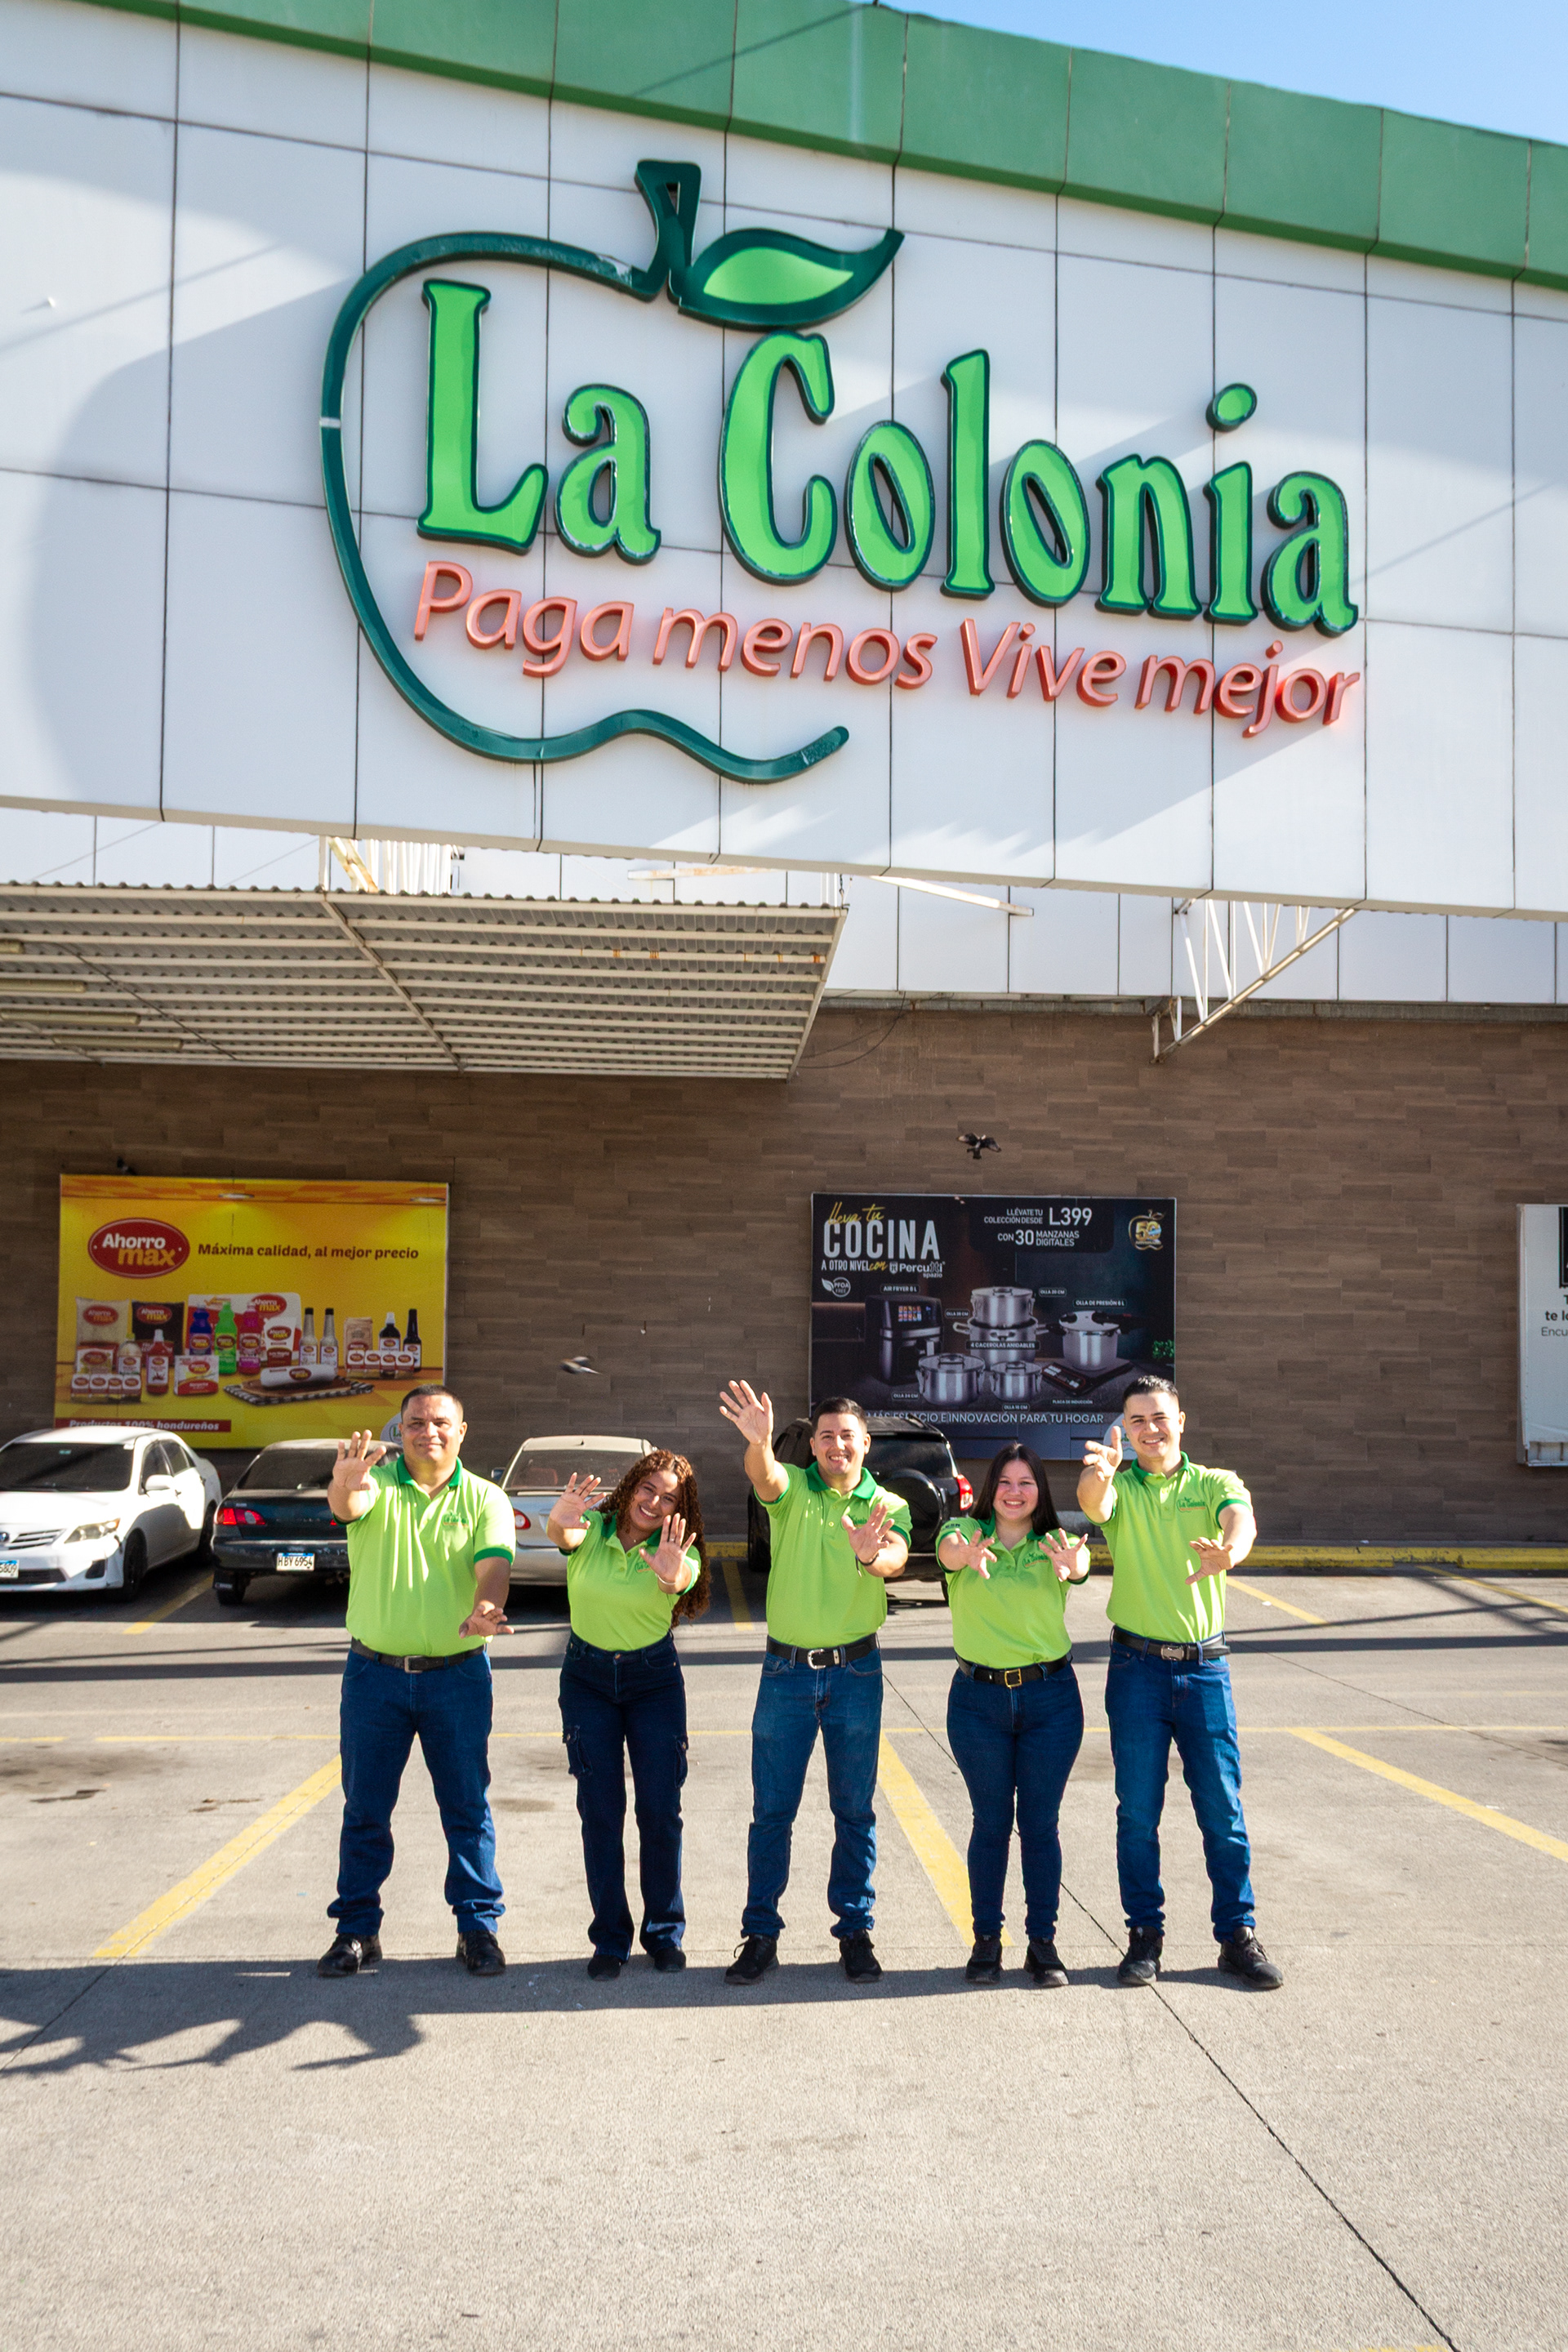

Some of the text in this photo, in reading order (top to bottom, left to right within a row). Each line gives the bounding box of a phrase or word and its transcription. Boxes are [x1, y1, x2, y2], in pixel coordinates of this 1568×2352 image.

[416, 278, 1360, 636] La Colonia
[414, 560, 1361, 738] Paga menos Vive mejor
[828, 1201, 885, 1224] lleva tu
[984, 1215, 1043, 1224] COLECCIÓN DESDE
[1049, 1207, 1093, 1226] L399
[102, 1232, 166, 1250] Ahorro
[823, 1218, 940, 1259] COCINA
[997, 1229, 1034, 1245] CON 30
[1036, 1230, 1080, 1239] MANZANAS
[1036, 1238, 1075, 1247] DIGITALES
[118, 1248, 176, 1267] max
[198, 1242, 419, 1260] Máxima calidad, al mejor precio
[821, 1259, 889, 1272] A OTRO NIVEL con
[1545, 1310, 1557, 1321] te
[941, 1413, 947, 1423] E
[948, 1410, 1018, 1423] INNOVACIÓN
[1019, 1413, 1048, 1423] PARA
[1049, 1413, 1062, 1423] TU
[1065, 1413, 1104, 1423] HOGAR
[156, 1419, 220, 1431] hondureños
[278, 1557, 313, 1567] HBY 6954
